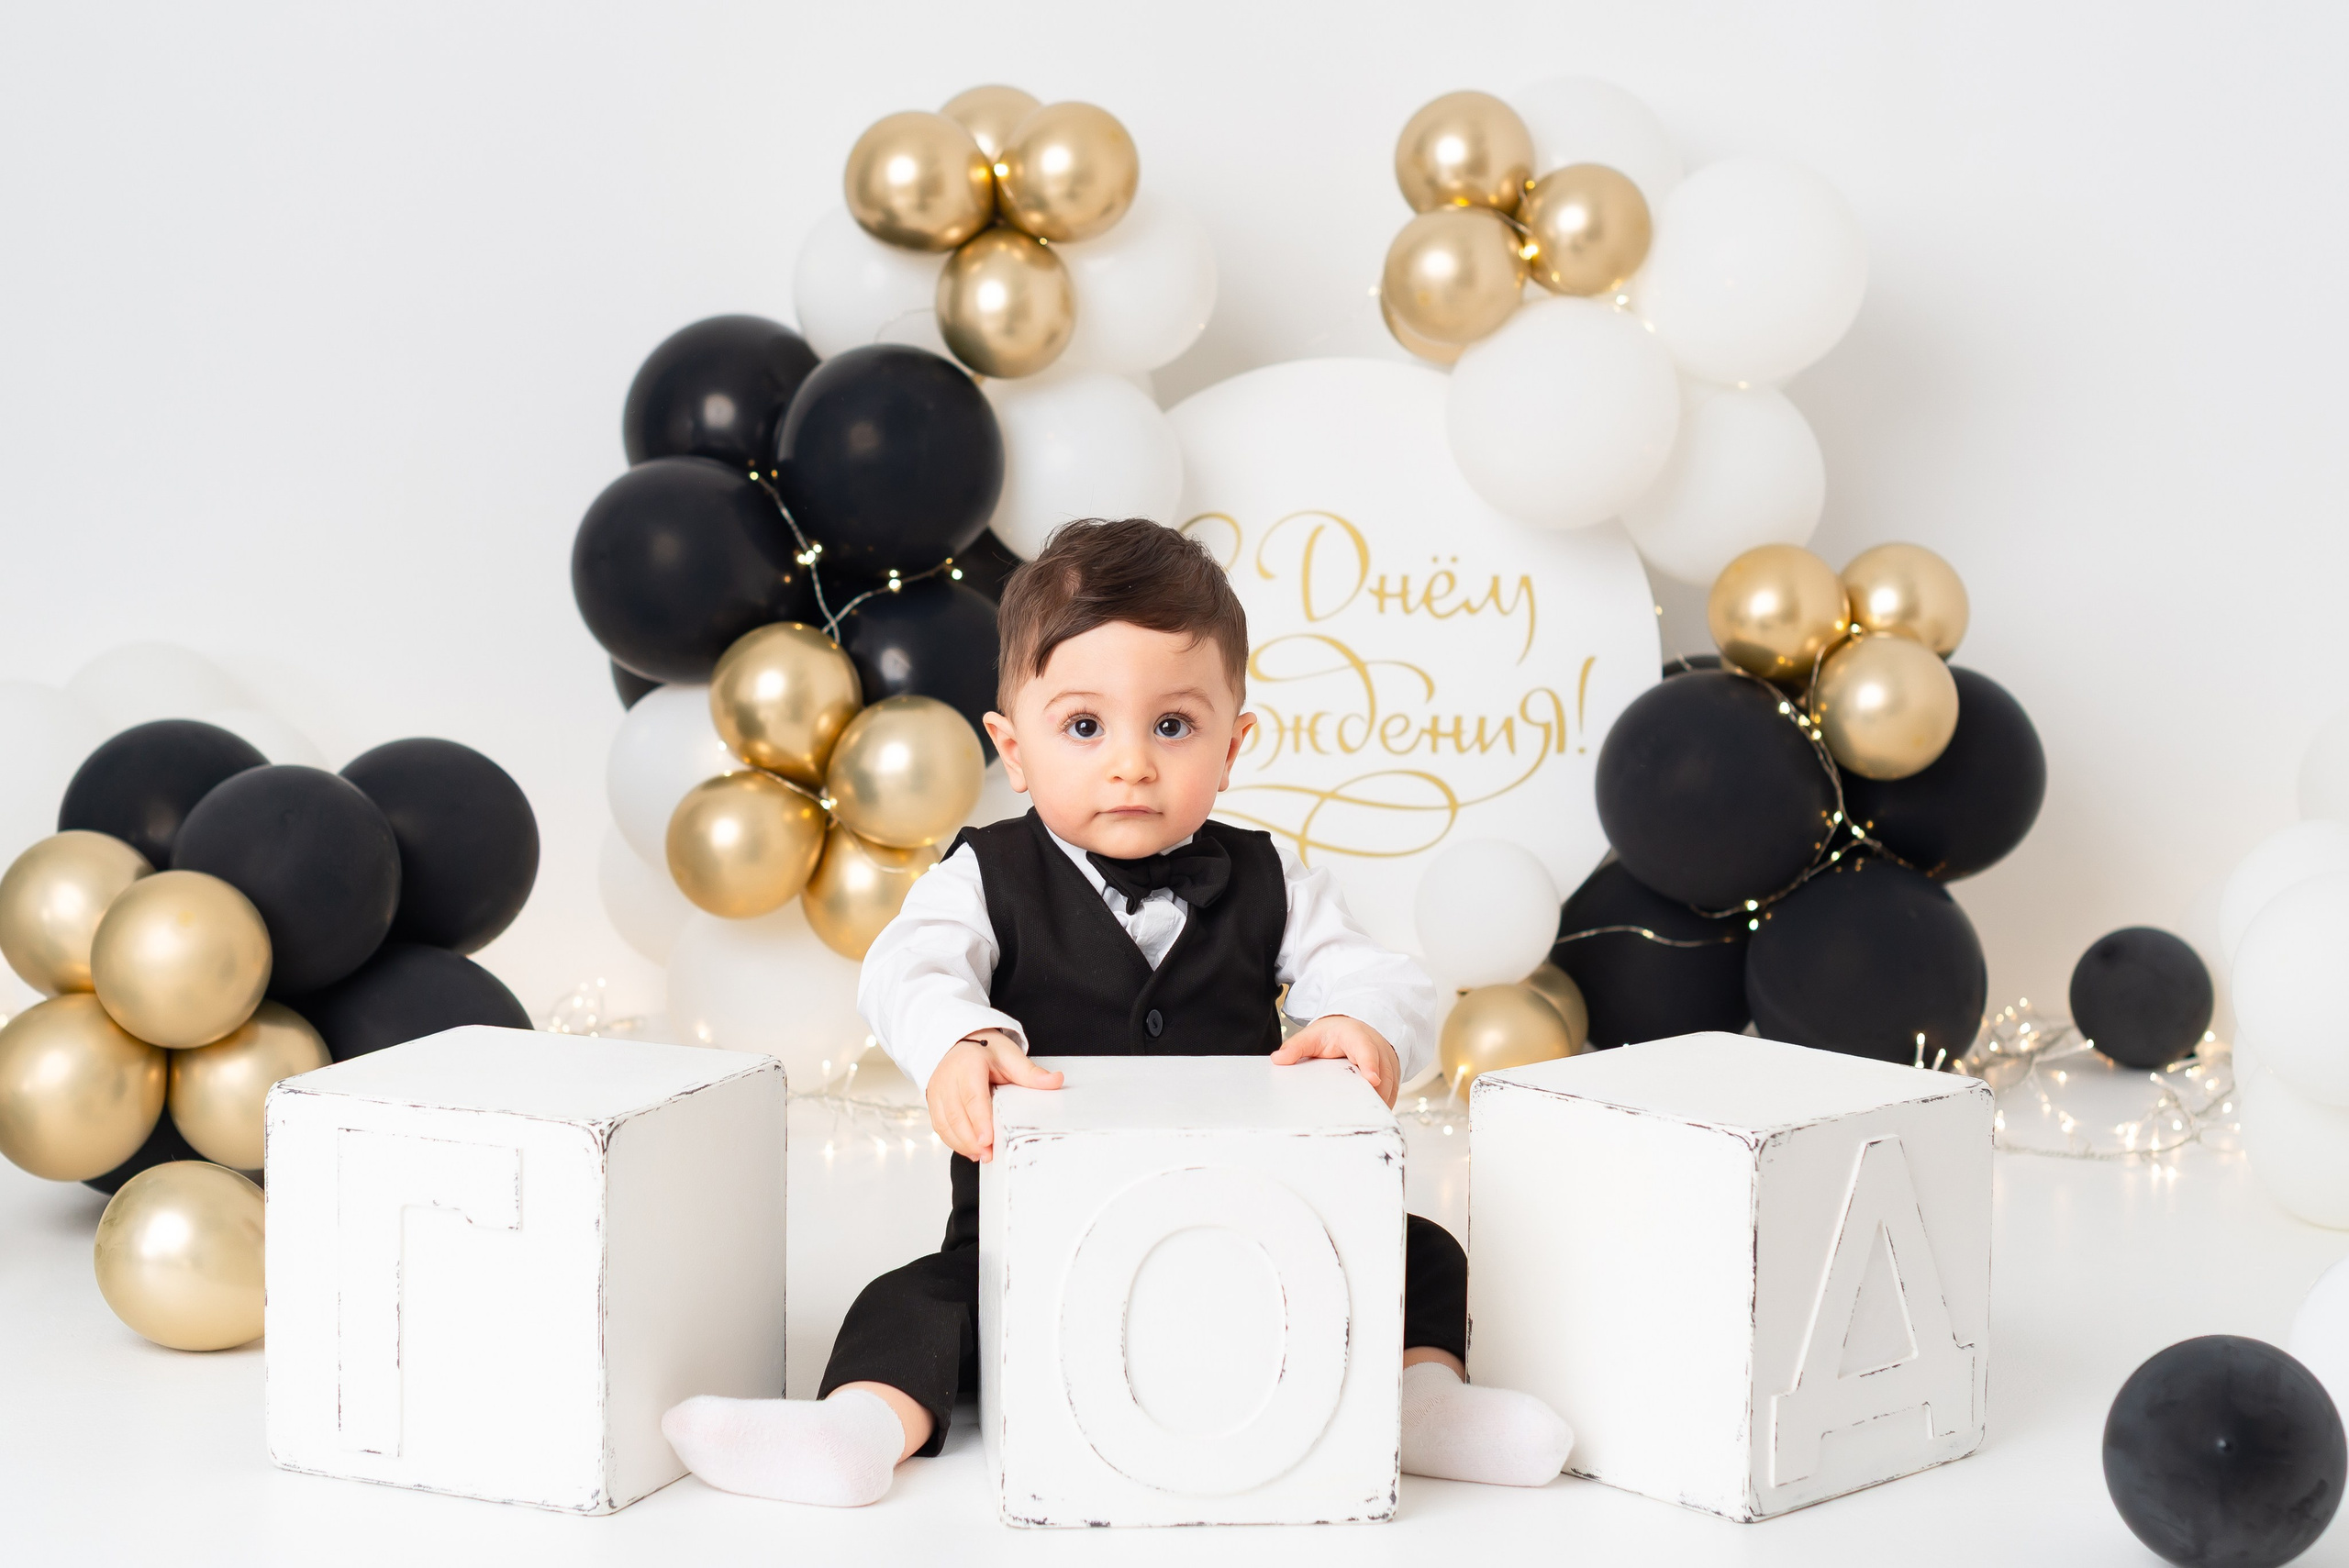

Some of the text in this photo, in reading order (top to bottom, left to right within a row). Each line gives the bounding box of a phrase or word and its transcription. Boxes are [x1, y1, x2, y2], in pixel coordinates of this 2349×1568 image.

[1255, 509, 1536, 666] Днём
[1228, 633, 1597, 812] ждения!
[1769, 1134, 1976, 1488] Д
